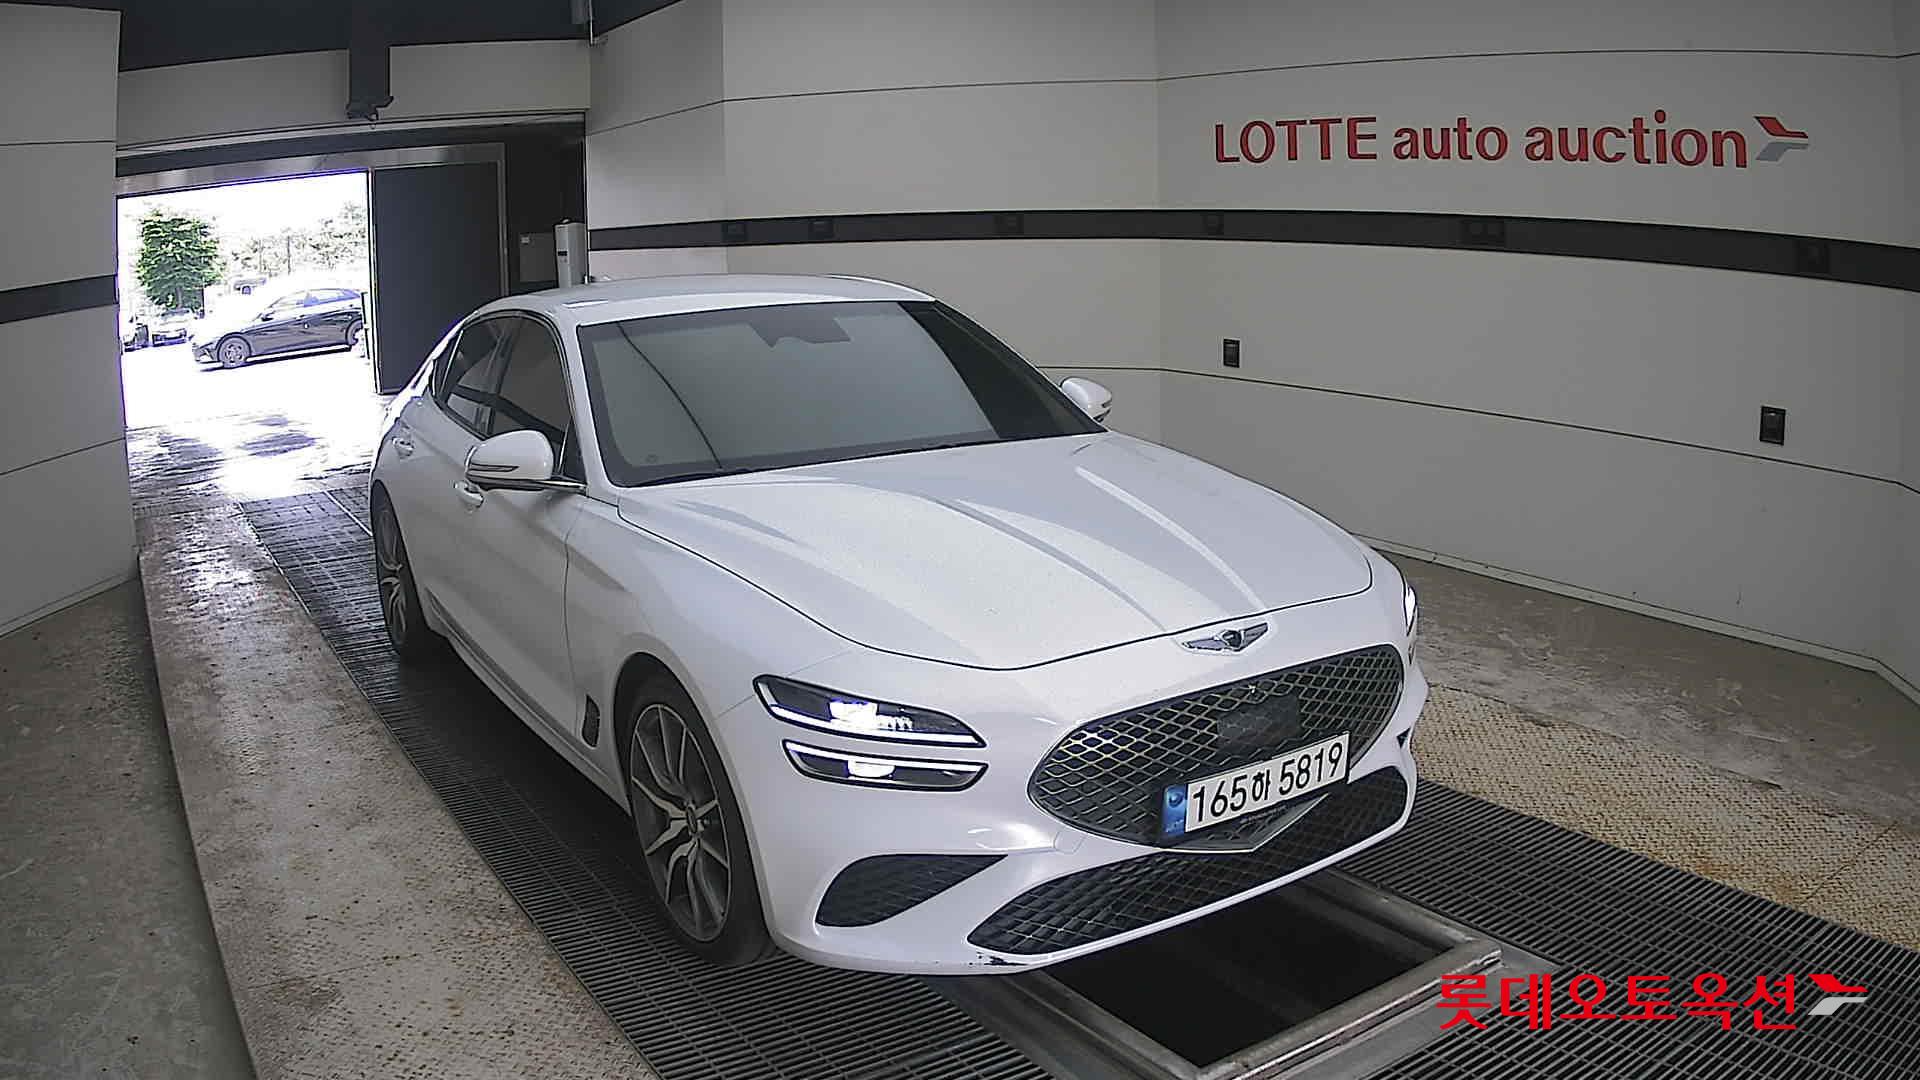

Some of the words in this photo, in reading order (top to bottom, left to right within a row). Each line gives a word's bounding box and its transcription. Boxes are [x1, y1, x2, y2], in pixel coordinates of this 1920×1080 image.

[1216, 117, 1377, 163] LOTTE
[1393, 117, 1508, 161] auto
[1524, 109, 1748, 168] auction
[1193, 769, 1271, 822] 165하
[1279, 742, 1343, 796] 5819
